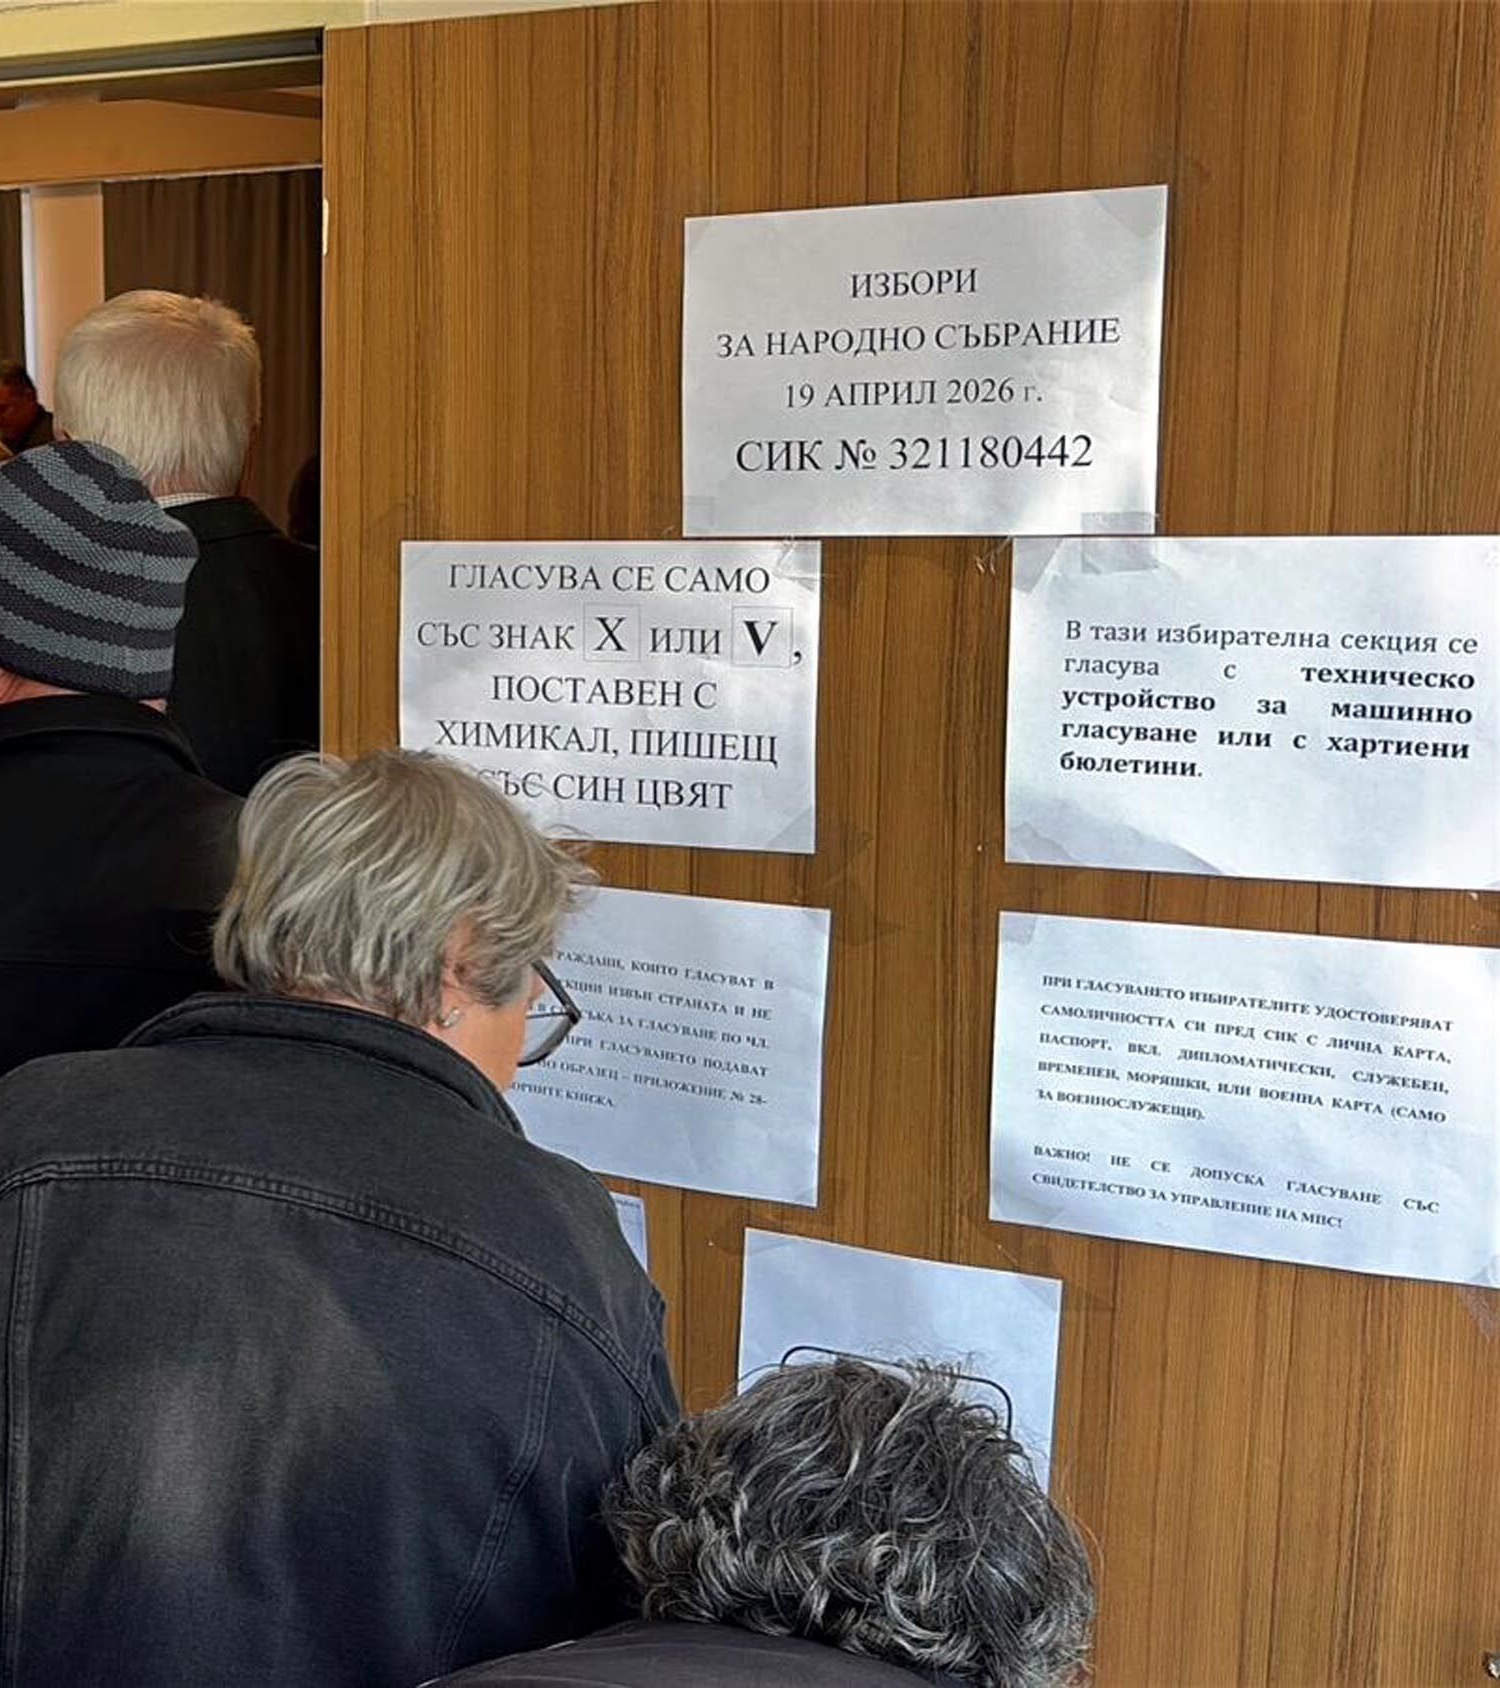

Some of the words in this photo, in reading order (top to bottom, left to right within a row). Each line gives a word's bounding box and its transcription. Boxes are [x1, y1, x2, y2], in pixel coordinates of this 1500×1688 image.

[852, 268, 978, 298] ИЗБОРИ
[717, 333, 753, 358] ЗА
[767, 326, 925, 355] НАРОДНО
[936, 317, 1121, 349] СЪБРАНИЕ
[787, 384, 815, 408] 19
[825, 380, 936, 407] АПРИЛ
[946, 377, 1015, 404] 2026
[1024, 383, 1042, 403] г.
[737, 440, 822, 472] СИК
[835, 439, 876, 470] №
[889, 435, 1093, 470] 321180442
[449, 563, 601, 590] ГЛАСУВА
[612, 566, 654, 592] СЕ
[665, 566, 770, 594] САМО
[417, 623, 480, 648] СЪС
[490, 625, 574, 650] ЗНАК
[650, 628, 721, 654] ИЛИ
[1066, 621, 1081, 639] В
[1090, 626, 1147, 642] тази
[1157, 624, 1330, 650] избирателна
[1341, 632, 1437, 654] секция
[1448, 637, 1477, 653] се
[1064, 657, 1159, 679] гласува
[1224, 664, 1236, 678] с
[1302, 664, 1475, 689] техническо
[491, 675, 681, 707] ПОСТАВЕН
[694, 682, 717, 708] С
[1062, 689, 1216, 712] устройство
[1257, 699, 1287, 716] за
[1331, 704, 1473, 724] машинно
[436, 720, 619, 757] ХИМИКАЛ,
[629, 729, 777, 765] ПИШЕЩ
[1061, 724, 1196, 749] гласуване
[1218, 730, 1271, 748] или
[1293, 735, 1306, 749] с
[1327, 737, 1470, 760] хартиени
[1061, 753, 1203, 777] бюлетини.
[554, 773, 623, 803] СИН
[634, 780, 733, 810] ЦВЯТ
[1042, 975, 1071, 988] ПРИ
[1075, 978, 1185, 1001] ГЛАСУВАНЕТО
[1189, 991, 1310, 1016] ИЗБИРАТЕЛИТЕ
[1314, 1005, 1454, 1033] УДОСТОВЕРЯВАТ
[1041, 1004, 1175, 1030] САМОЛИЧНОСТТА
[1184, 1019, 1205, 1032] СИ
[1215, 1024, 1255, 1039] ПРЕД
[1264, 1029, 1297, 1044] СИК
[1307, 1034, 1318, 1046] С
[1326, 1037, 1383, 1054] ЛИЧНА
[1037, 1089, 1053, 1101] ЗА
[1218, 1083, 1251, 1097] ИЛИ
[1259, 1087, 1323, 1107] ВОЕННА
[1332, 1097, 1383, 1115] КАРТА
[1390, 1104, 1446, 1124] (САМО
[1034, 1146, 1090, 1163] ВАЖНО!
[1111, 1155, 1131, 1168] НЕ
[1151, 1159, 1170, 1172] СЕ
[1190, 1165, 1264, 1186] ДОПУСКА
[1287, 1180, 1381, 1205] ГЛАСУВАНЕ
[1403, 1198, 1440, 1214] СЪС
[1033, 1172, 1145, 1198] СВИДЕТЕЛСТВО
[1149, 1187, 1168, 1201] ЗА
[1171, 1192, 1272, 1218] УПРАВЛЕНИЕ
[1276, 1207, 1298, 1222] НА
[1302, 1213, 1341, 1228] МПС!
